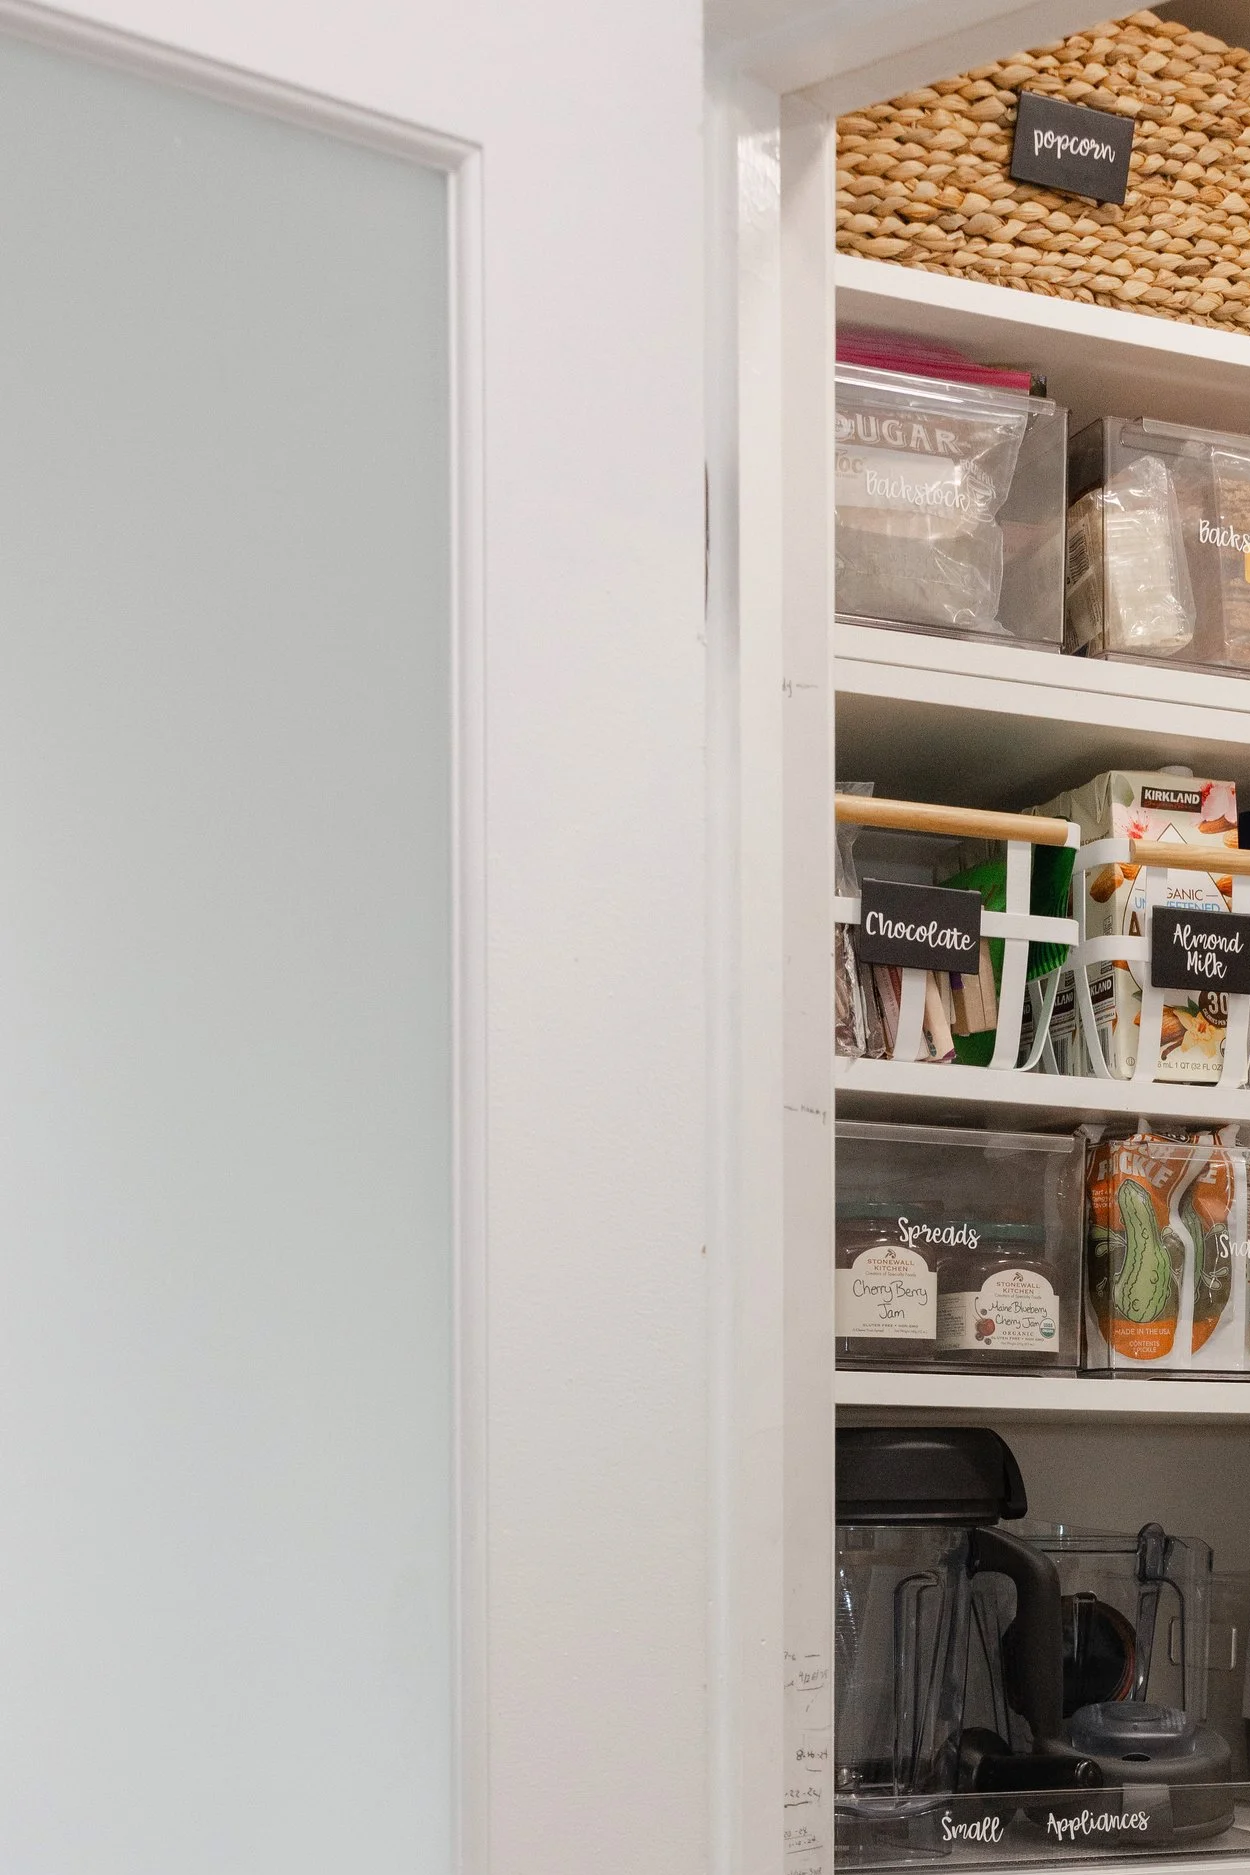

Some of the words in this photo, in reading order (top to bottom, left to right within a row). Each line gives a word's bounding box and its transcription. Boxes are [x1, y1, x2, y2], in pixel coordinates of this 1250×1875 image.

[1034, 128, 1115, 163] popcorn
[866, 469, 970, 512] Backstock
[1144, 788, 1201, 805] KIRKLAND
[866, 911, 976, 950] Chocolate
[1173, 923, 1244, 954] Almond
[1187, 950, 1228, 979] Milk
[1180, 1062, 1190, 1070] QT
[1202, 1063, 1211, 1071] FL
[898, 1216, 981, 1250] Spreads
[867, 1258, 915, 1266] STONEWALL
[853, 1278, 894, 1303] Cherry
[890, 1280, 928, 1306] Berry
[996, 1281, 1041, 1289] STONEWALL
[877, 1302, 905, 1319] Jam
[988, 1301, 1012, 1313] Maine
[1011, 1301, 1048, 1318] Blueberry
[995, 1313, 1021, 1329] Cherry
[1022, 1317, 1040, 1329] Jam
[1159, 1327, 1171, 1335] USA
[1129, 1340, 1160, 1348] CONTENTS
[941, 1815, 1004, 1843] Small
[1047, 1810, 1150, 1841] Appliances
